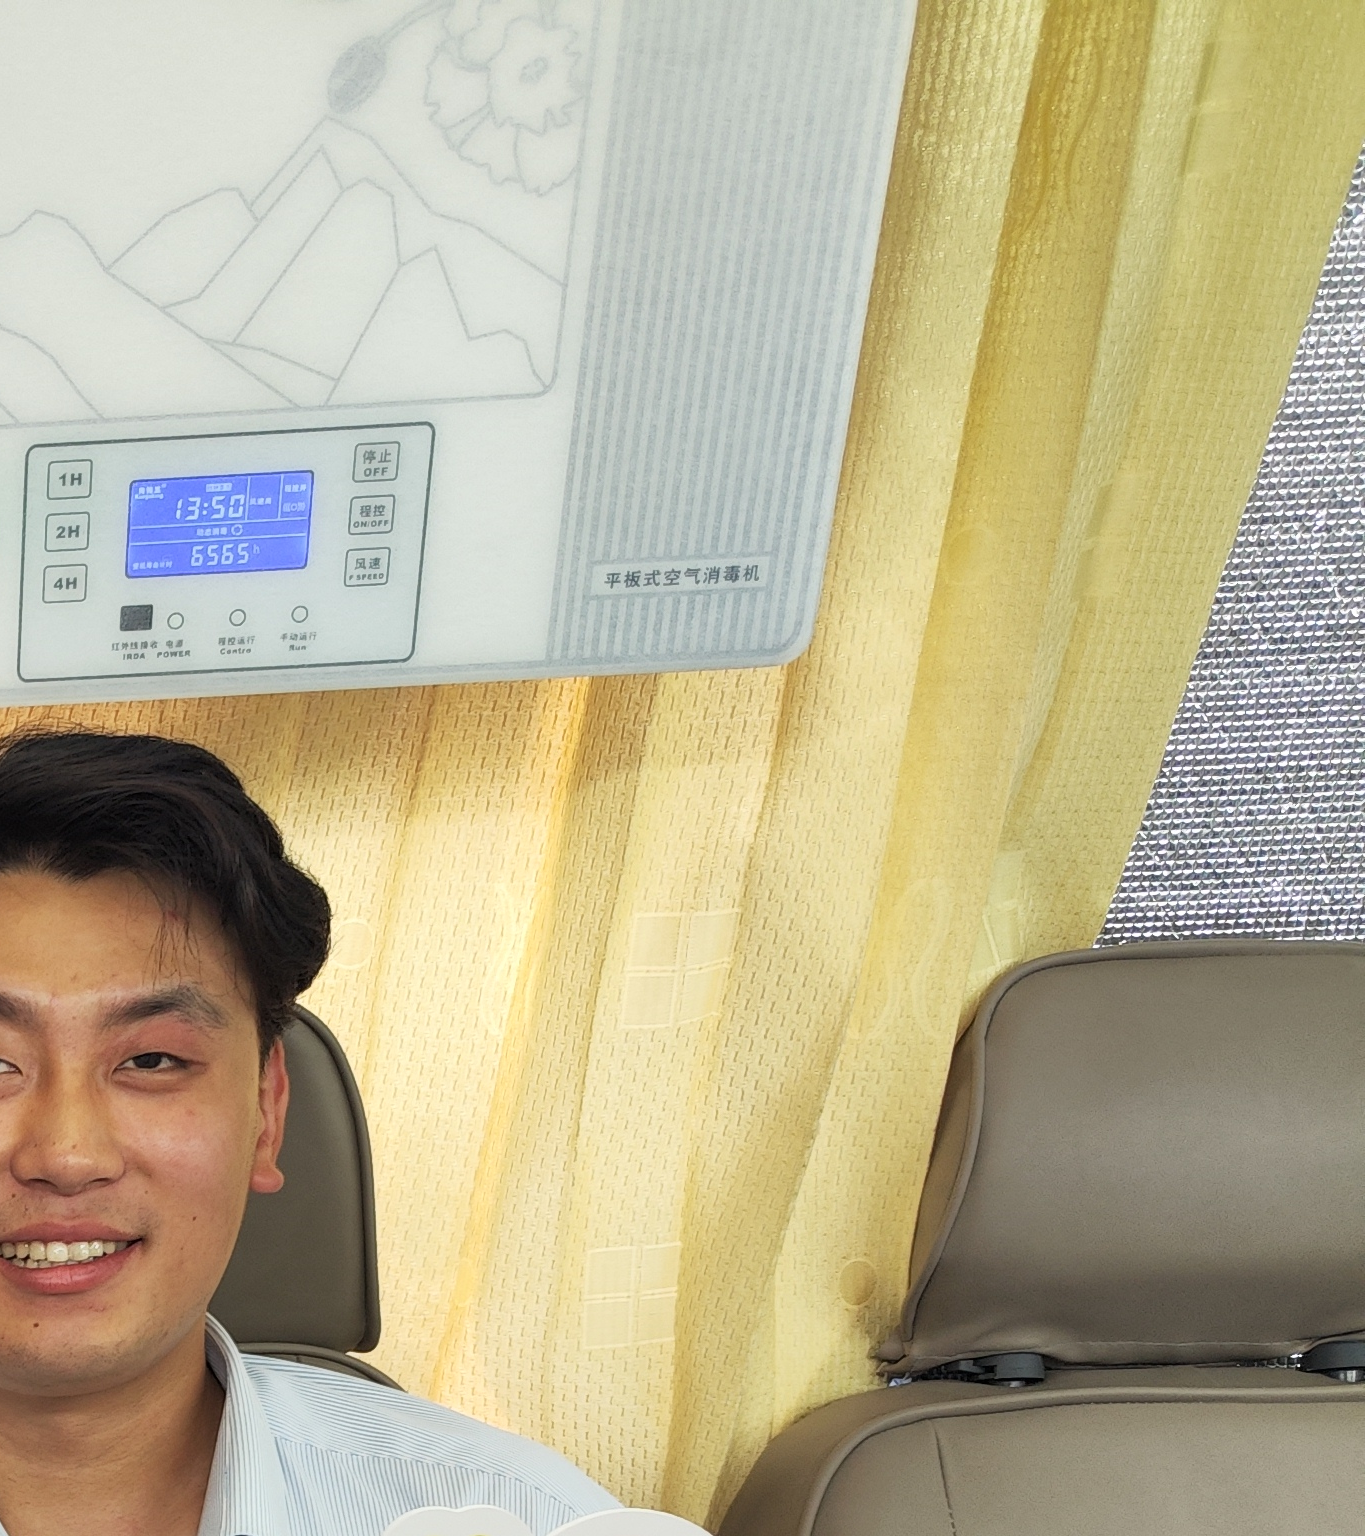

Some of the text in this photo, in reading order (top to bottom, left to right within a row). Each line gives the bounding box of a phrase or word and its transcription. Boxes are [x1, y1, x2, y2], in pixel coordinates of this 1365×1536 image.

[362, 448, 392, 464] 停止
[363, 466, 389, 477] OFF
[58, 472, 83, 487] 1H
[175, 493, 246, 521] 13:50
[359, 504, 386, 518] 程控
[352, 519, 390, 529] ON/OFF
[55, 524, 80, 540] 2H
[190, 542, 250, 567] 6565
[354, 557, 381, 571] 风速
[53, 576, 78, 590] 4H
[604, 564, 760, 589] 平板式空气消毒机
[156, 650, 191, 658] POWER
